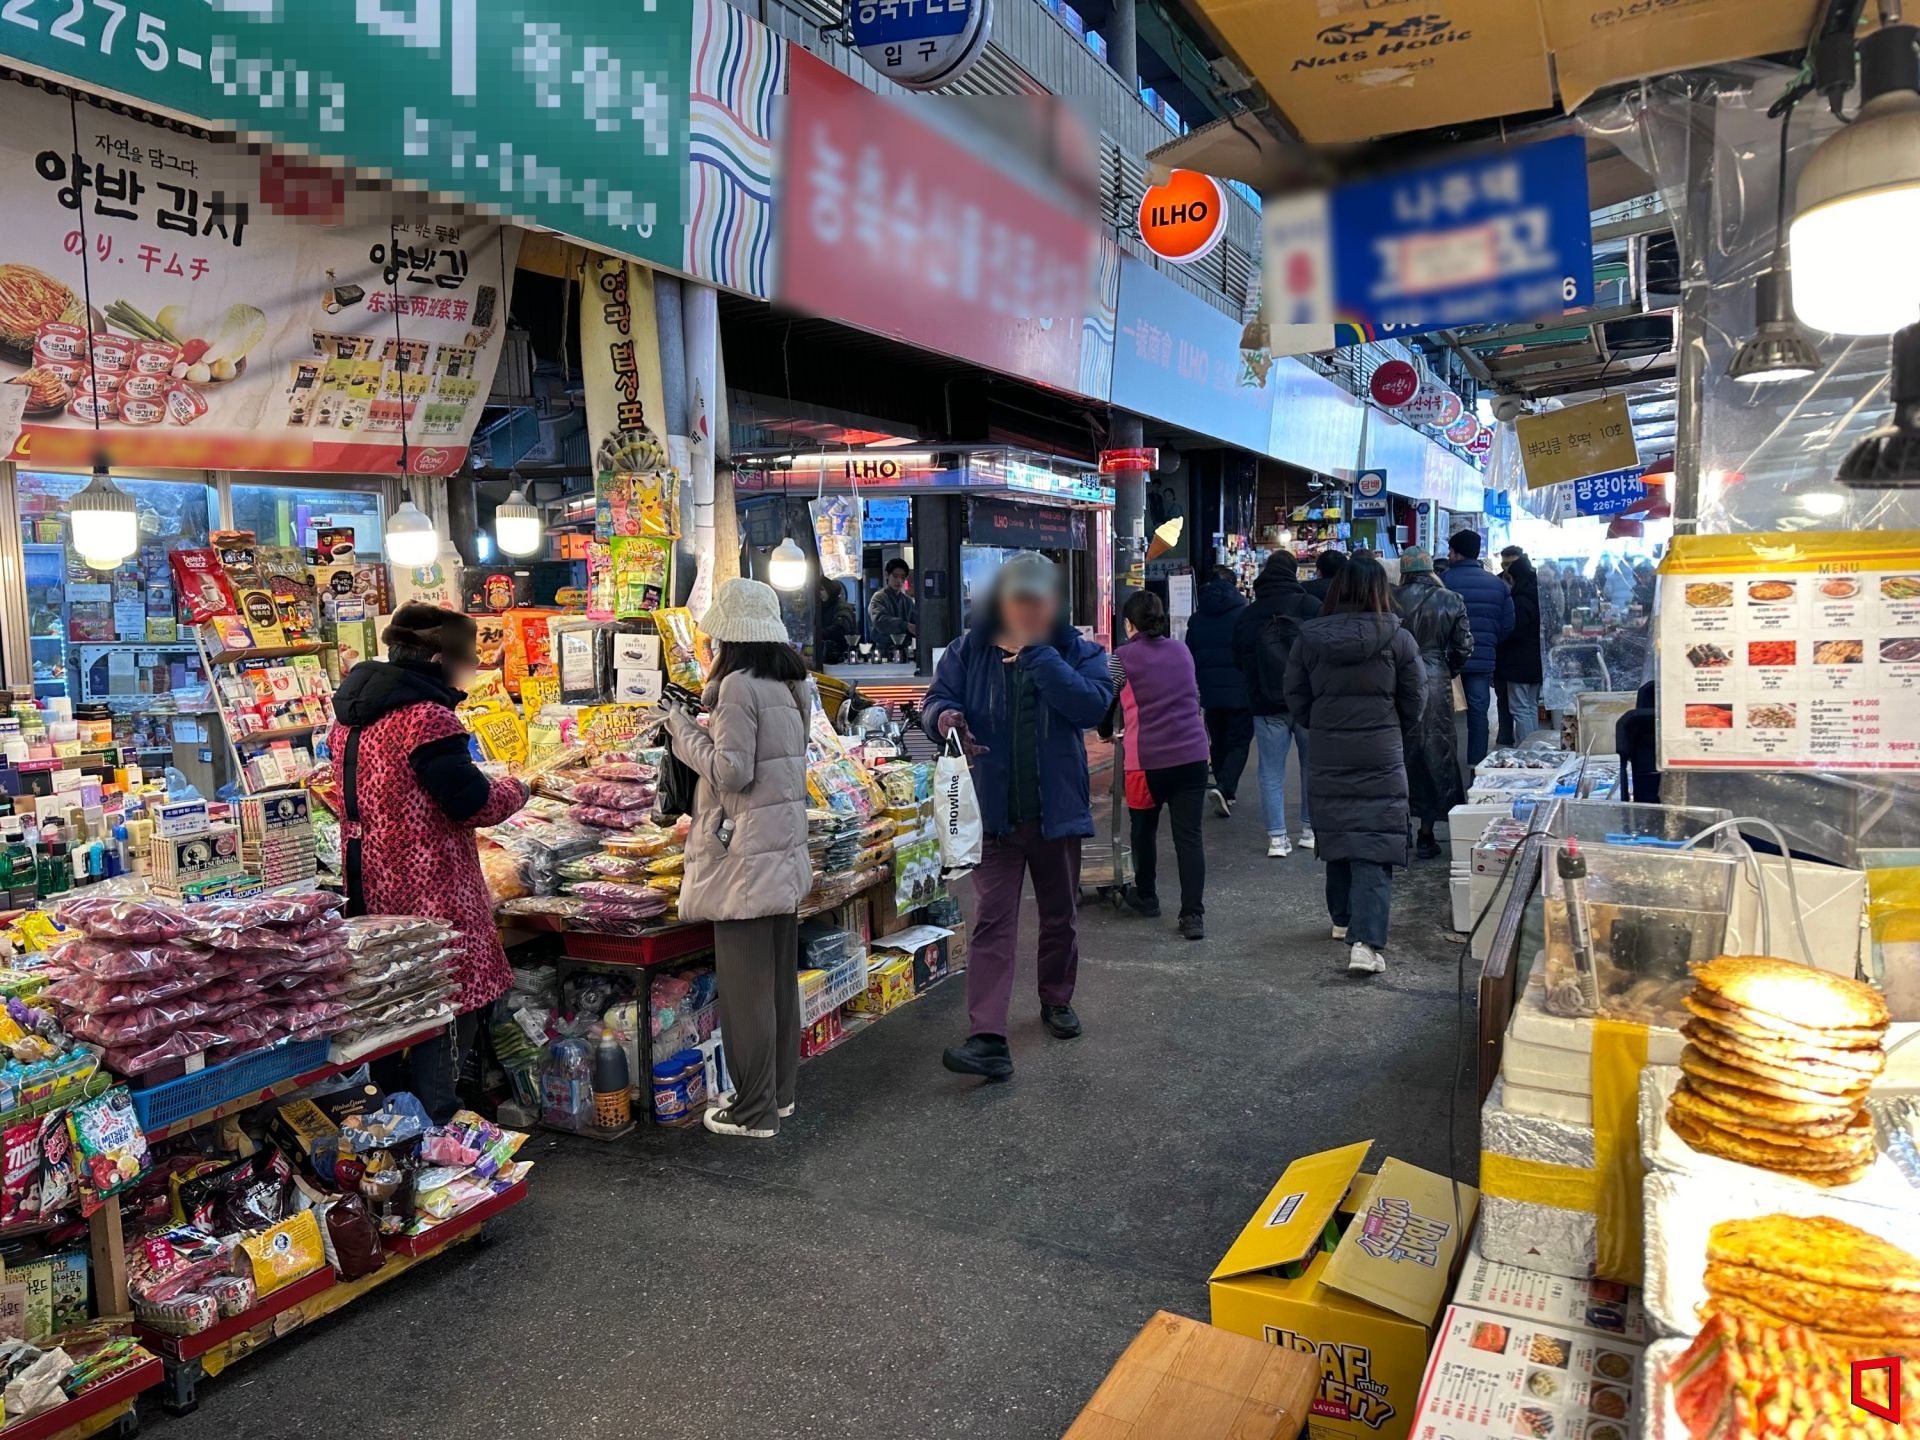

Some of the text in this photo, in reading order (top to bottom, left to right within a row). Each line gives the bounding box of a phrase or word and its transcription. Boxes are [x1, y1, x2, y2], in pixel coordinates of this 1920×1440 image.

[885, 41, 937, 67] 입구
[1290, 49, 1368, 72] Nuts
[1377, 29, 1473, 56] Holic
[95, 134, 199, 180] 자연을 담그다.
[35, 150, 146, 221] 양반
[1151, 201, 1208, 228] ILHO
[369, 239, 469, 290] 양반김
[1567, 431, 1592, 449] 호떡
[1599, 423, 1625, 440] 10호
[845, 459, 897, 478] ILHO
[1361, 480, 1380, 490] 담배
[1577, 472, 1644, 501] 광장야채
[1818, 563, 1860, 575] MENU
[486, 718, 513, 737] HBAF
[602, 713, 637, 728] HBAF
[949, 774, 960, 836] snowline
[656, 1092, 677, 1105] SKIPPY
[101, 1126, 132, 1144] MITSUYA
[1358, 1198, 1411, 1258] VARIETY
[1394, 1213, 1450, 1267] HBAF
[1359, 1380, 1387, 1396] mini
[1312, 1402, 1347, 1416] LAVORS
